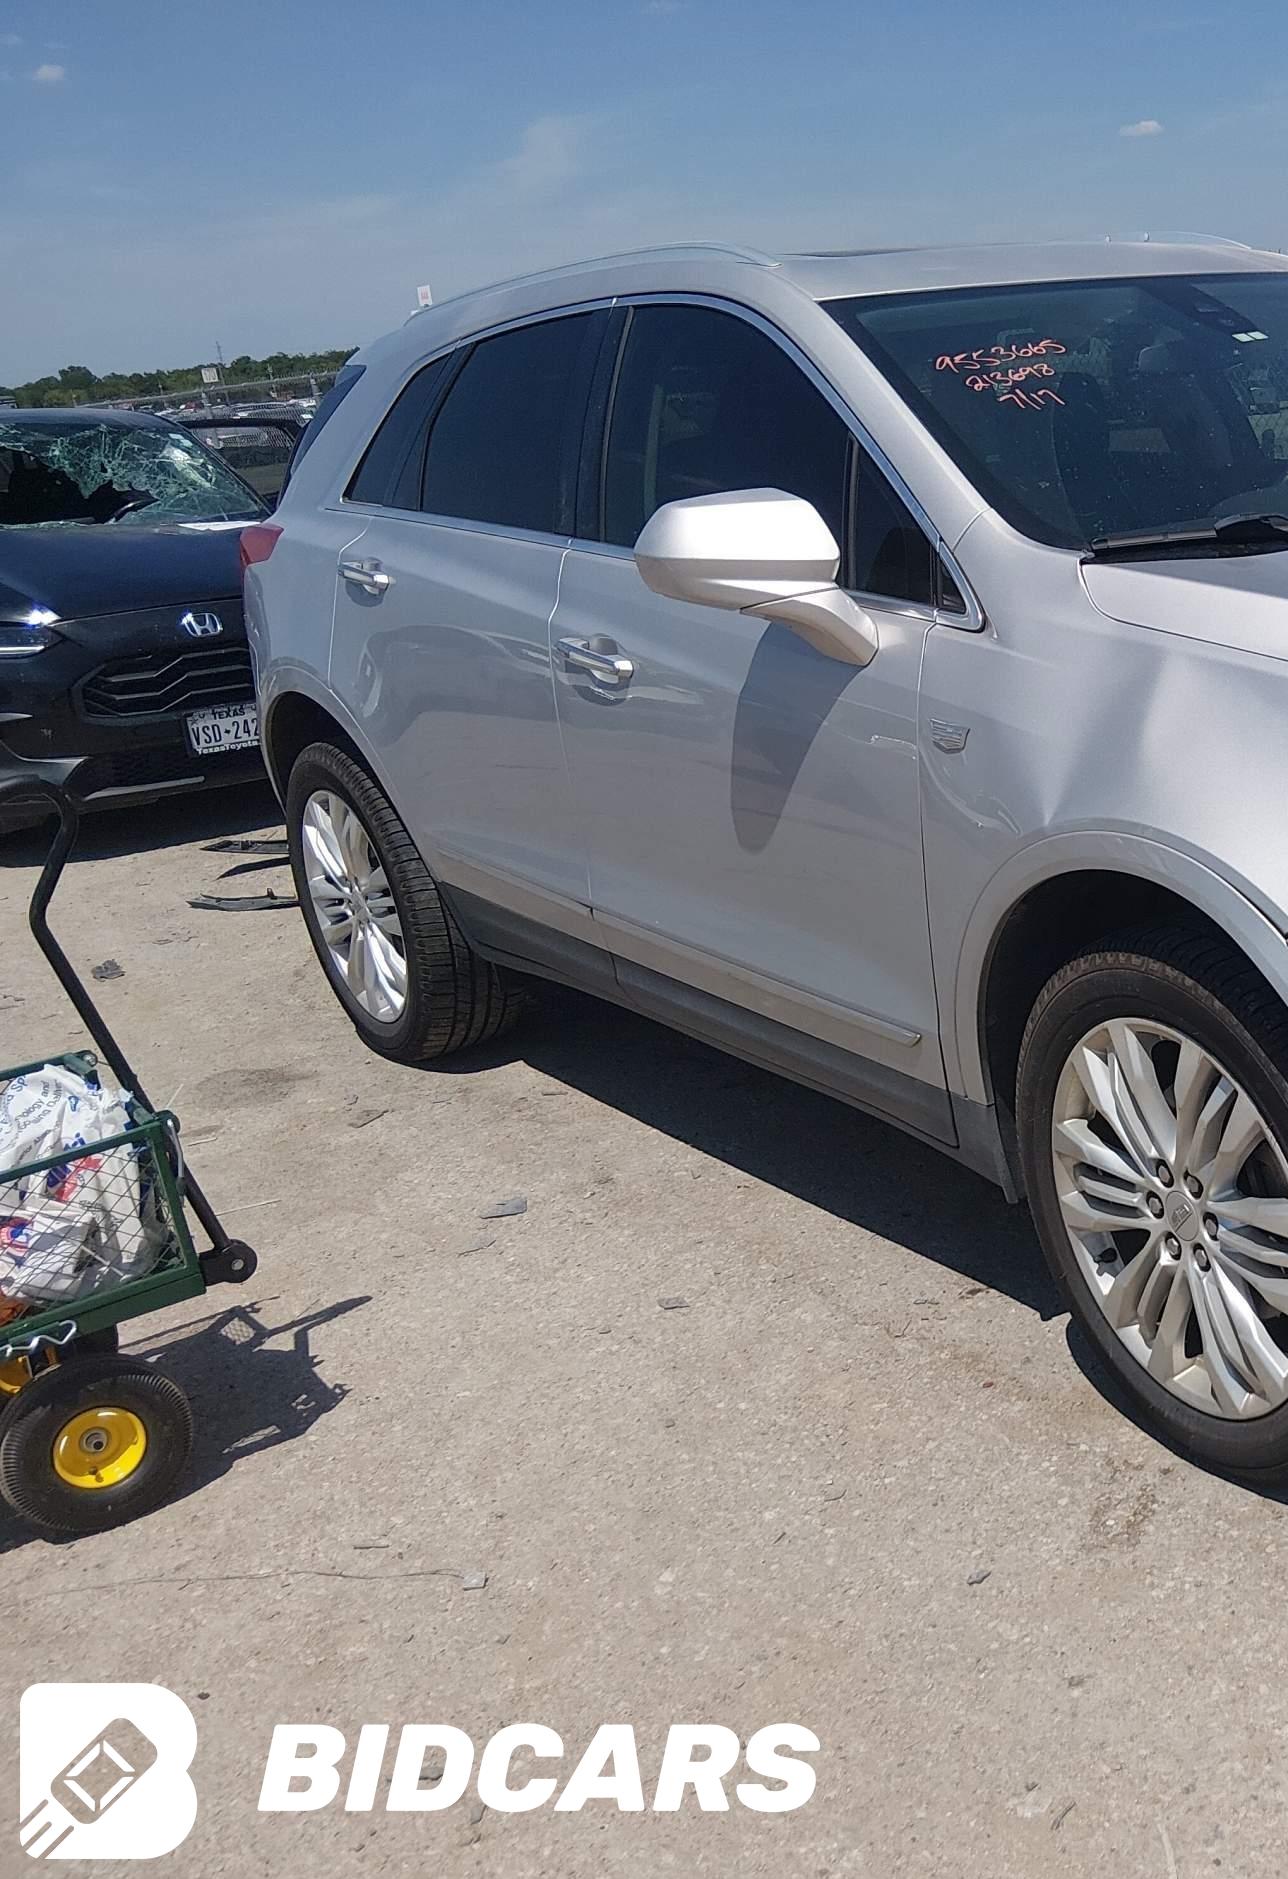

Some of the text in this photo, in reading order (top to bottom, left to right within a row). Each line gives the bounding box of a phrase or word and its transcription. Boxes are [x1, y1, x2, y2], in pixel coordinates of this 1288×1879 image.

[936, 339, 1066, 373] 9553665
[965, 363, 1055, 391] 213698
[211, 706, 246, 720] TEXAS
